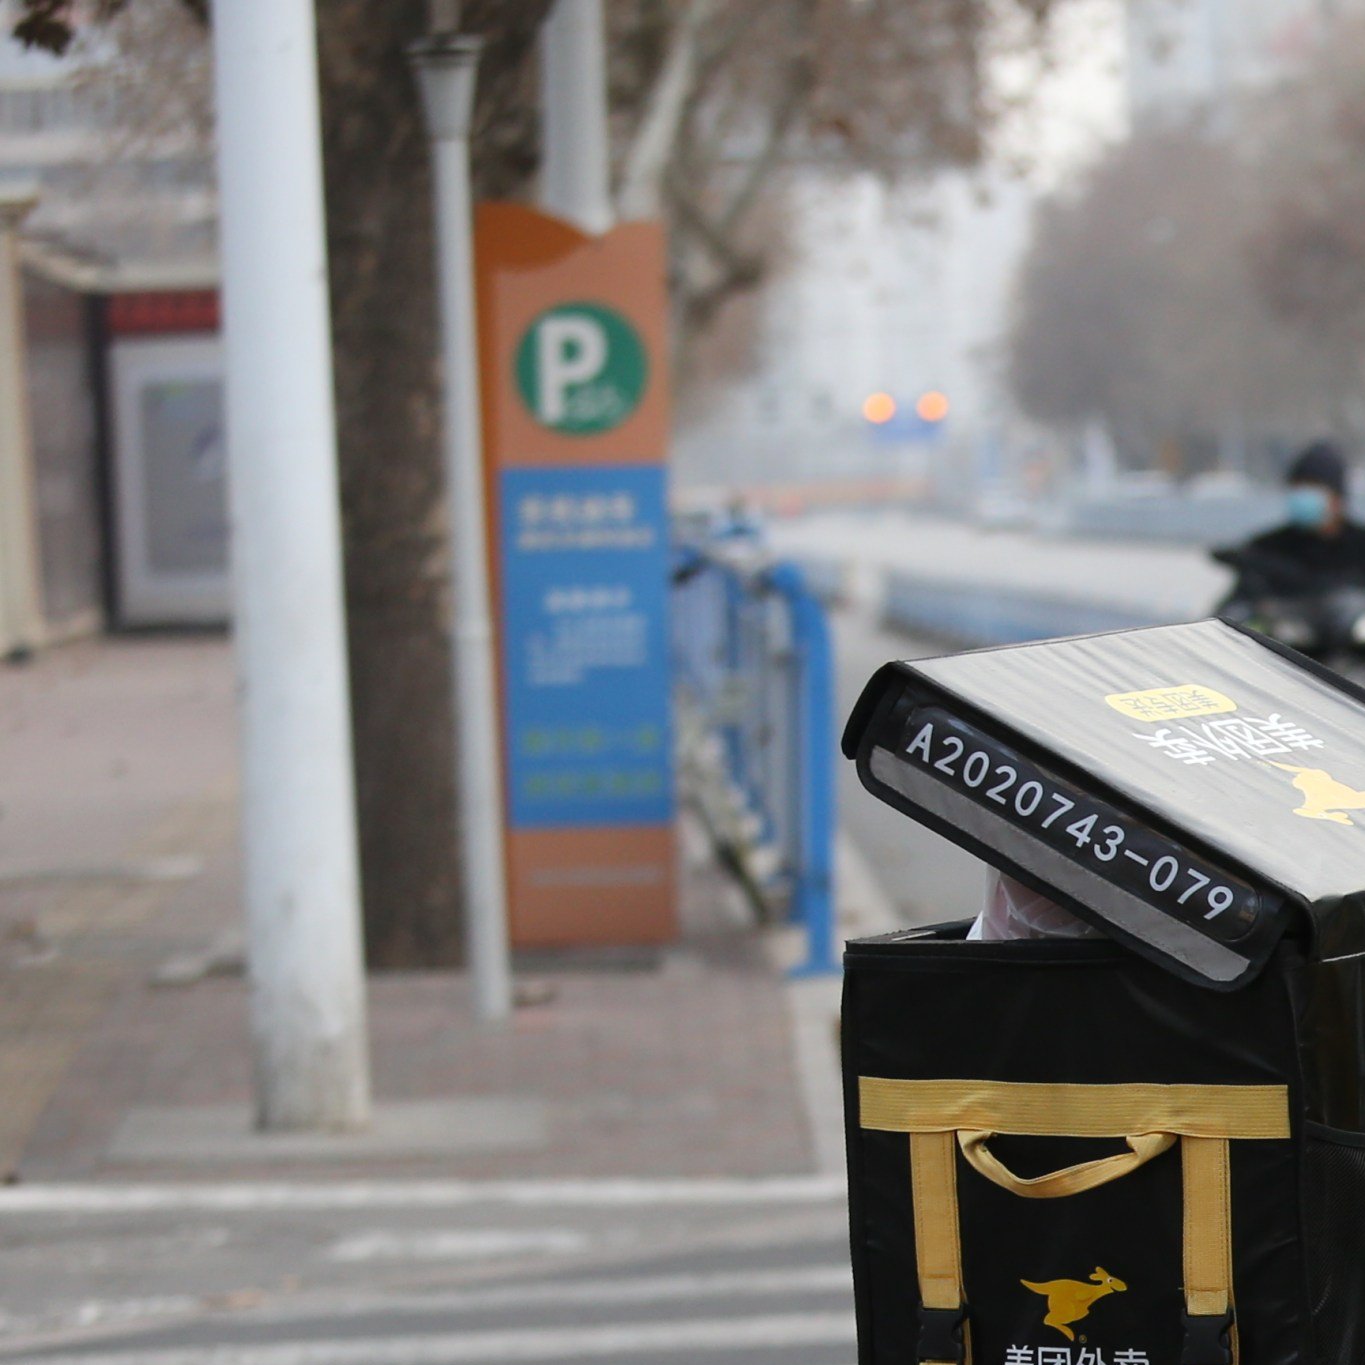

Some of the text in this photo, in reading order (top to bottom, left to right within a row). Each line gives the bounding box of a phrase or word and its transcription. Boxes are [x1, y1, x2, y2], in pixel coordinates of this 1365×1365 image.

[536, 313, 608, 424] P
[1119, 688, 1222, 718] 美团专送
[1132, 712, 1328, 766] 美团外卖
[905, 722, 1236, 922] A2020743-079
